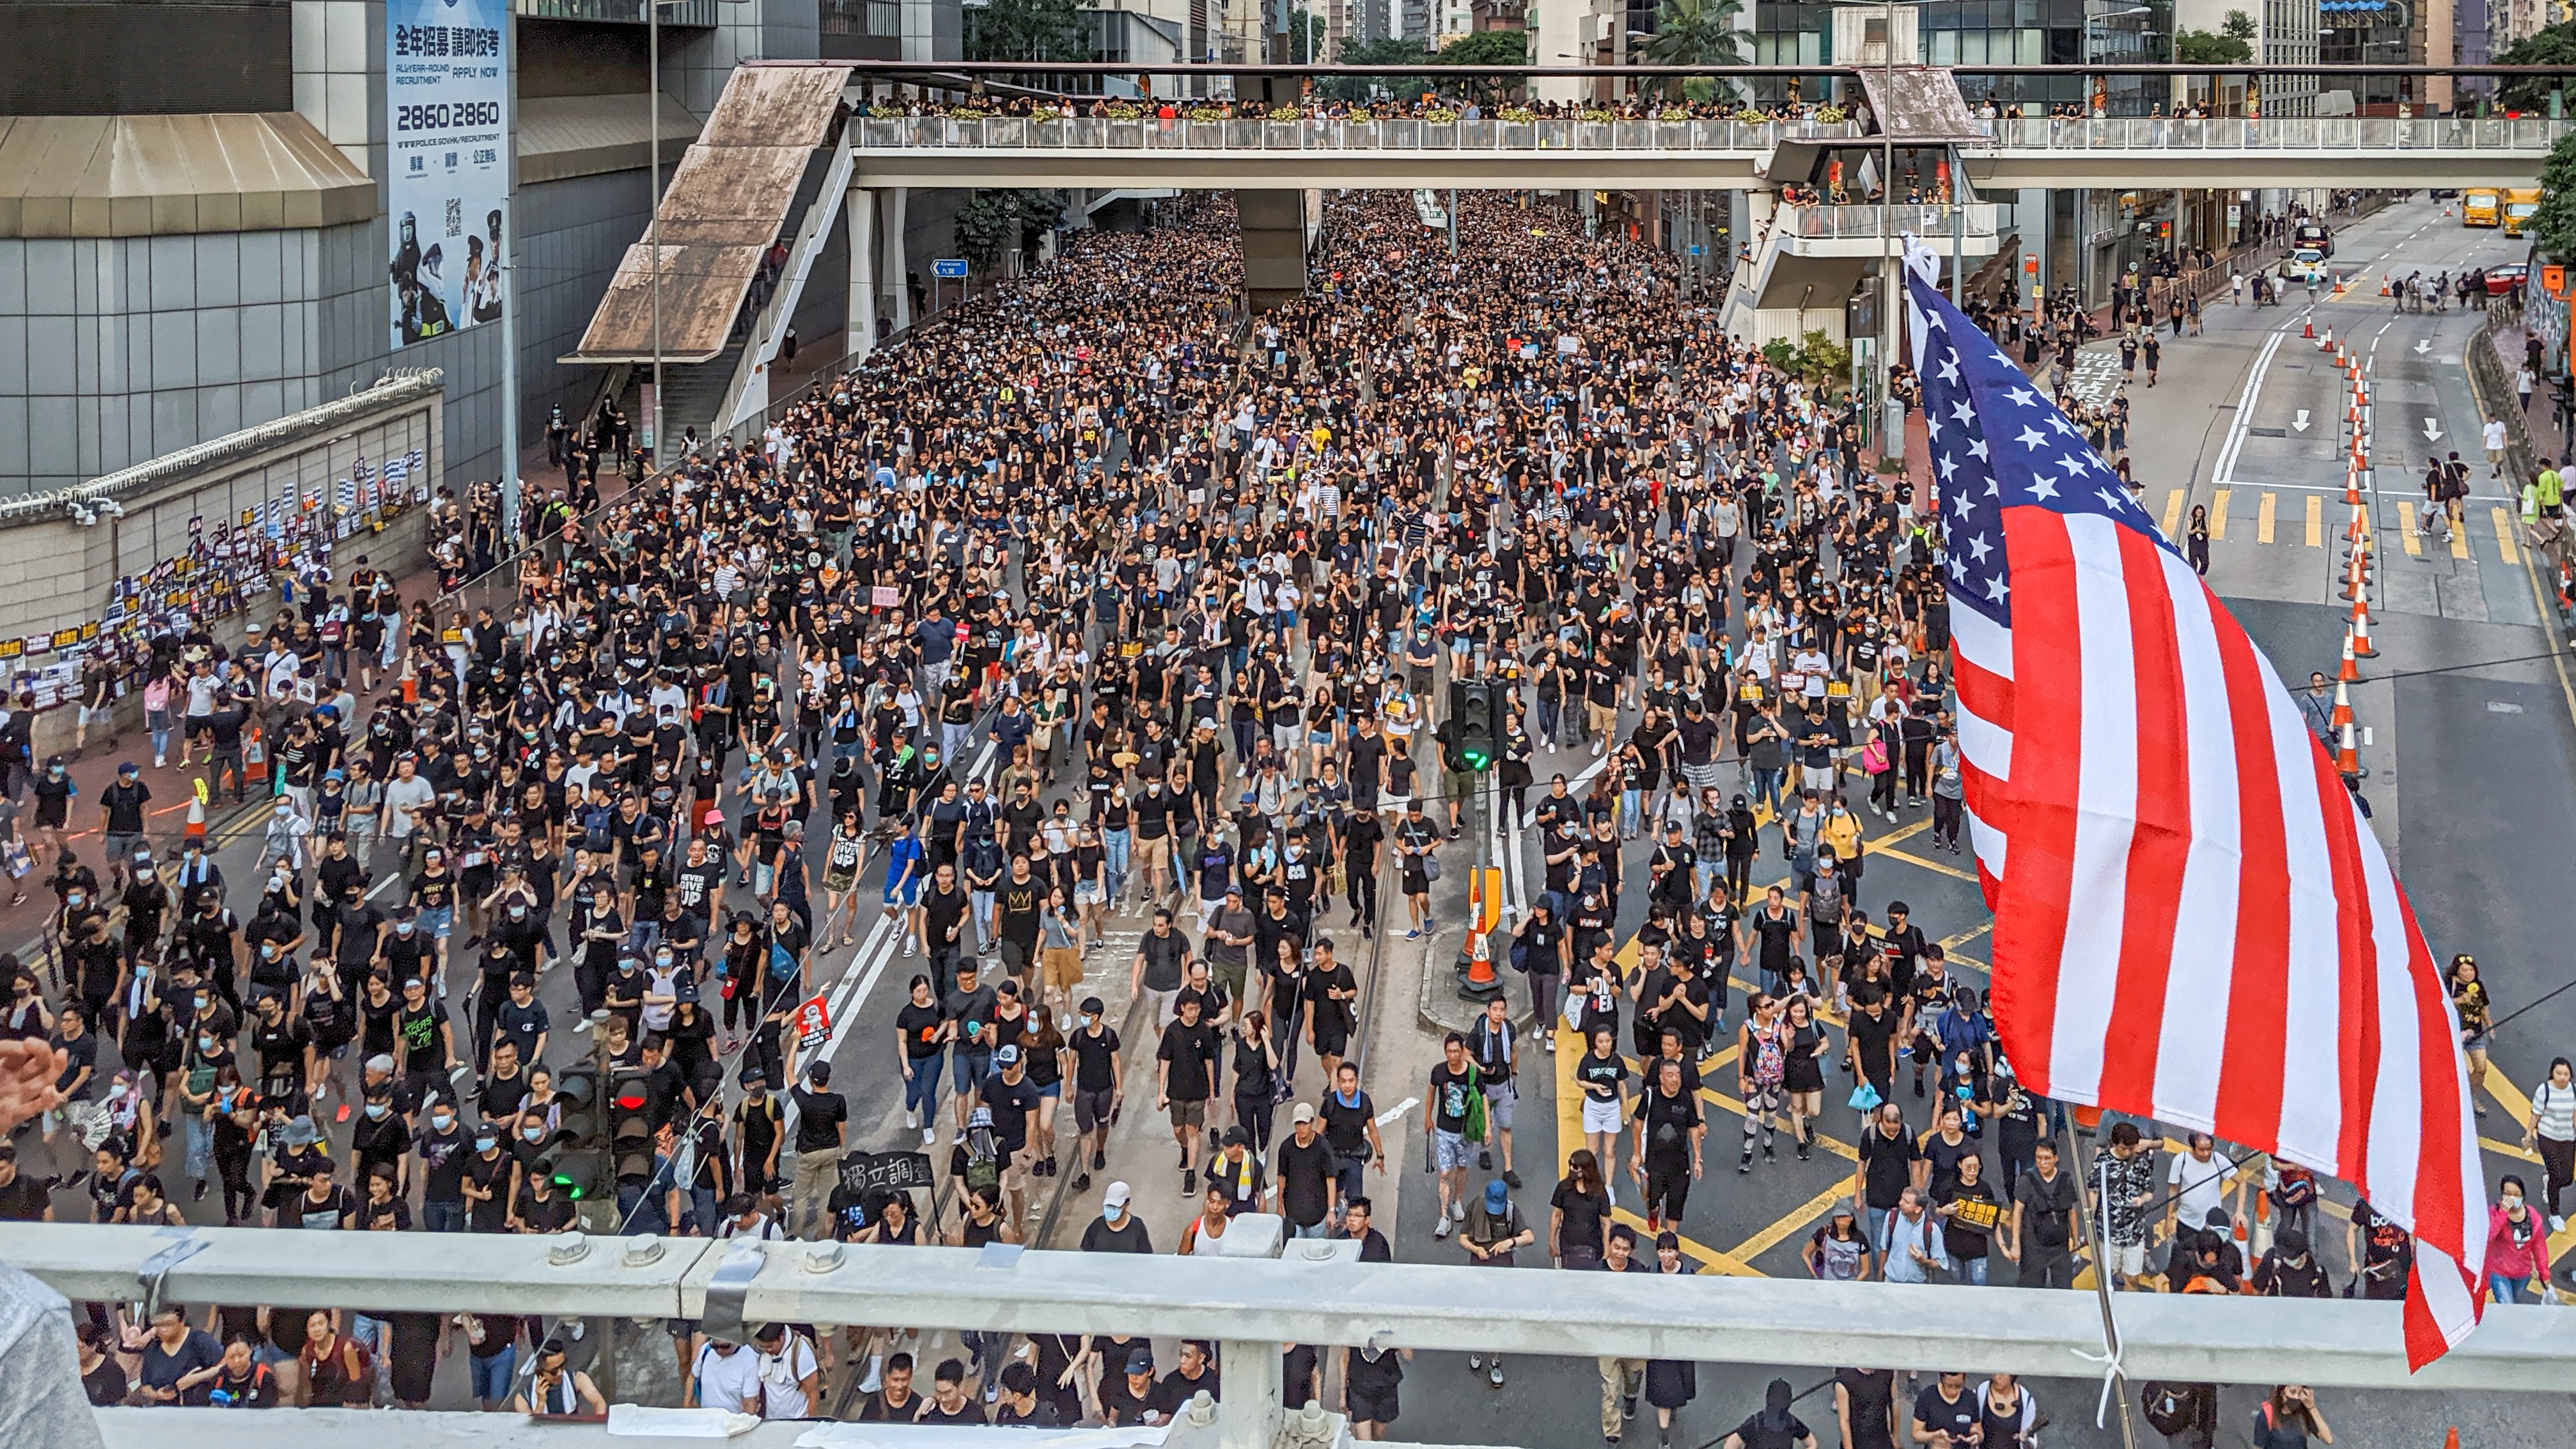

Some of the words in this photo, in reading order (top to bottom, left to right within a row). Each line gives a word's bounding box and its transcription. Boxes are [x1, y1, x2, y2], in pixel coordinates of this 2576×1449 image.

[396, 24, 449, 57] 全年招募
[451, 26, 499, 58] 請即投考
[396, 64, 449, 74] ALL-YEAR-ROUND
[453, 66, 477, 79] APPLY
[480, 67, 498, 77] NOW
[396, 75, 441, 85] RECRUITMENT
[397, 105, 449, 131] 2860
[453, 102, 499, 127] 2860
[834, 853, 855, 867] UP
[680, 873, 705, 883] NEVER
[423, 883, 444, 894] JUICY
[680, 880, 704, 892] GIVE
[680, 890, 701, 906] UP
[841, 1158, 932, 1191] 獨立調查
